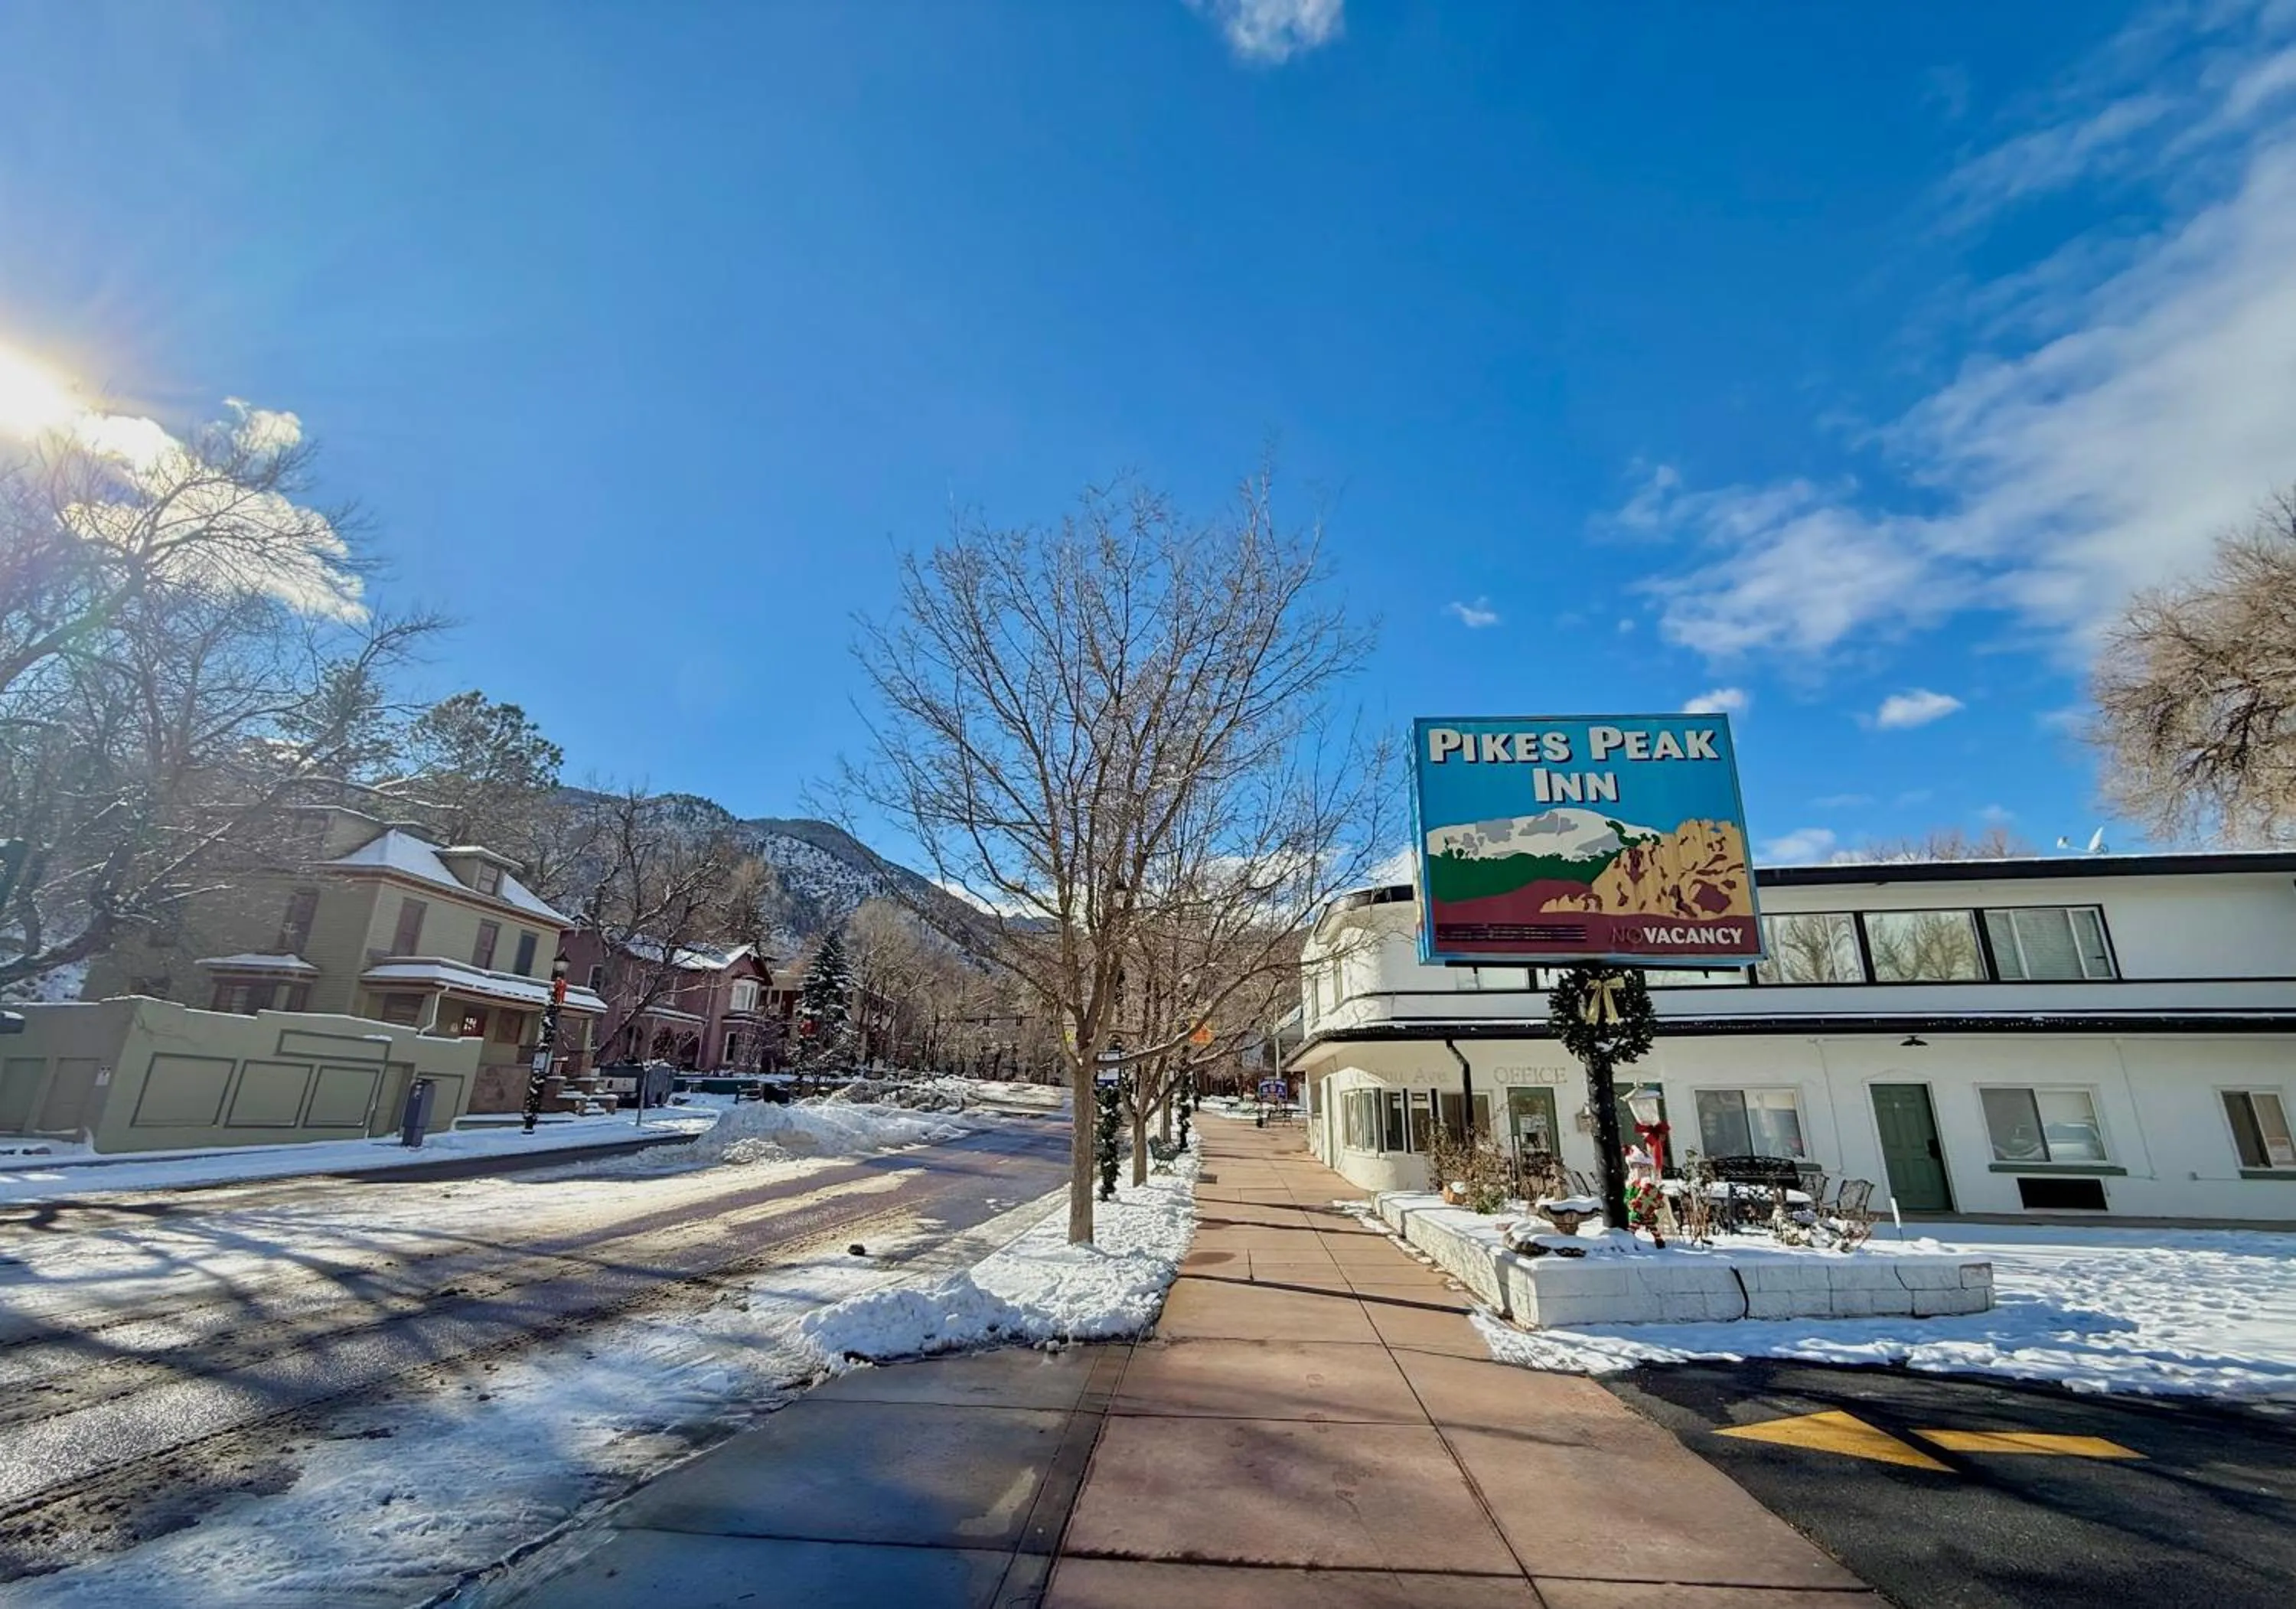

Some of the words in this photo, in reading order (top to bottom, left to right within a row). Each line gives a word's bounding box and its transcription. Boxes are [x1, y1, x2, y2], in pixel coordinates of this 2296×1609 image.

[1428, 728, 1572, 763] PIKES
[1588, 726, 1721, 761] PEAK
[1532, 768, 1619, 803] INN
[1643, 927, 1743, 944] VACANCY
[1493, 1066, 1567, 1084] OFFICE
